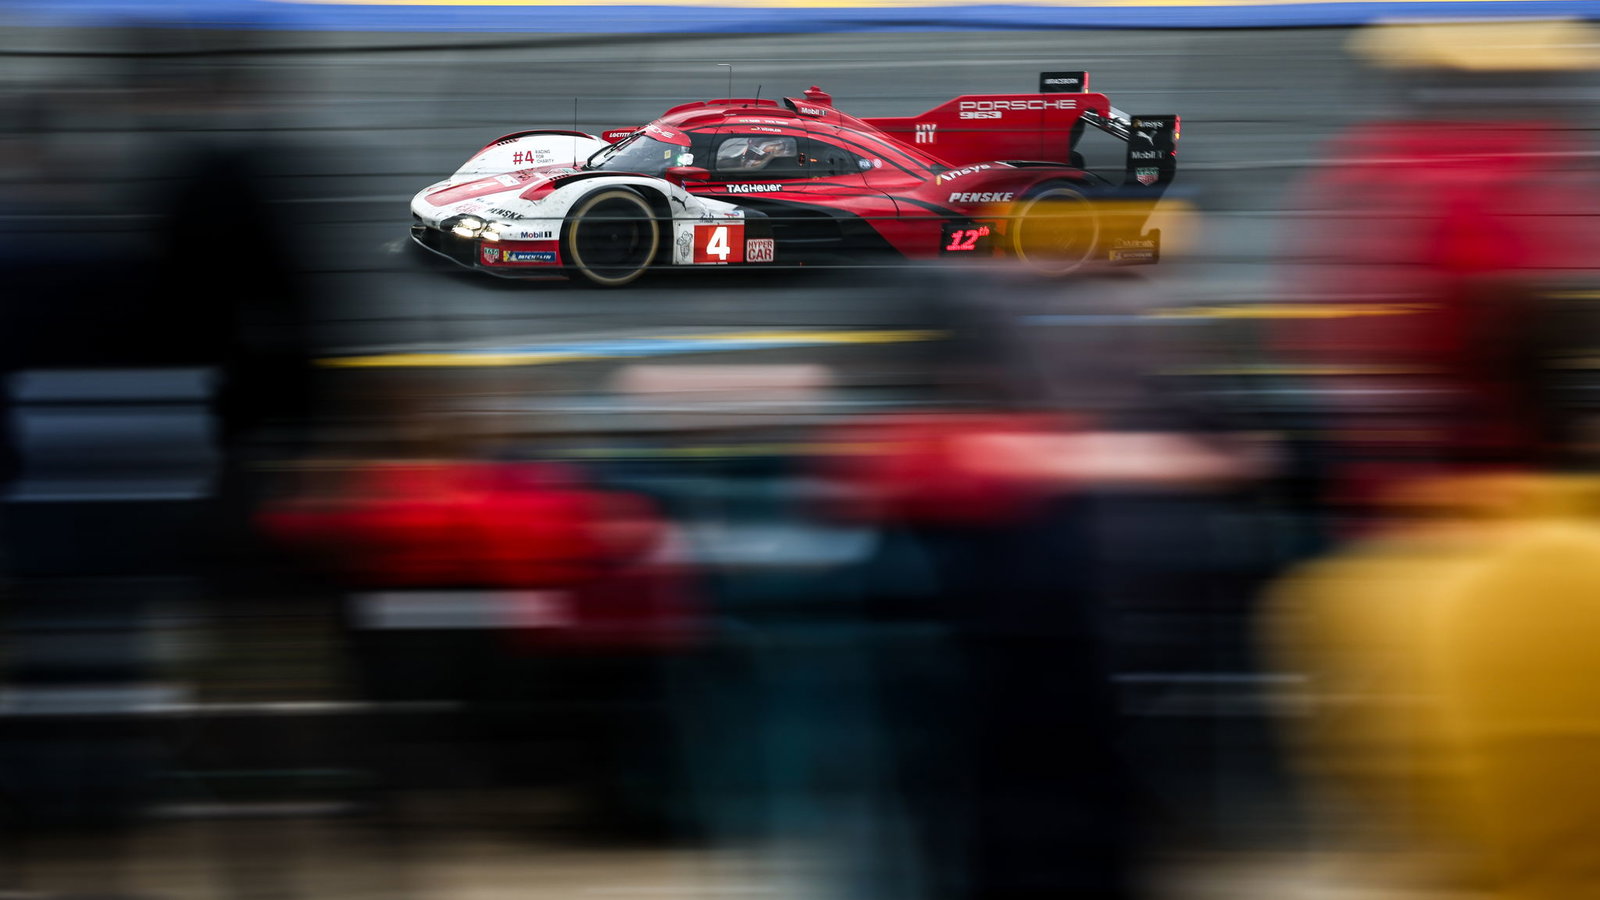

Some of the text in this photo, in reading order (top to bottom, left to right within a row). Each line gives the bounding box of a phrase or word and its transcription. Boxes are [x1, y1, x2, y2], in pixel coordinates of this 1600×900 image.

[960, 99, 1077, 111] PORSCHE
[801, 107, 820, 115] Mobil
[960, 111, 1002, 119] 963
[916, 124, 937, 143] HY
[513, 150, 534, 165] #4
[1132, 151, 1156, 159] Mobil
[948, 192, 1014, 203] PENSKE
[520, 231, 543, 239] Mobil
[706, 226, 730, 260] 4
[748, 240, 773, 249] HYPER
[748, 248, 773, 261] CAR
